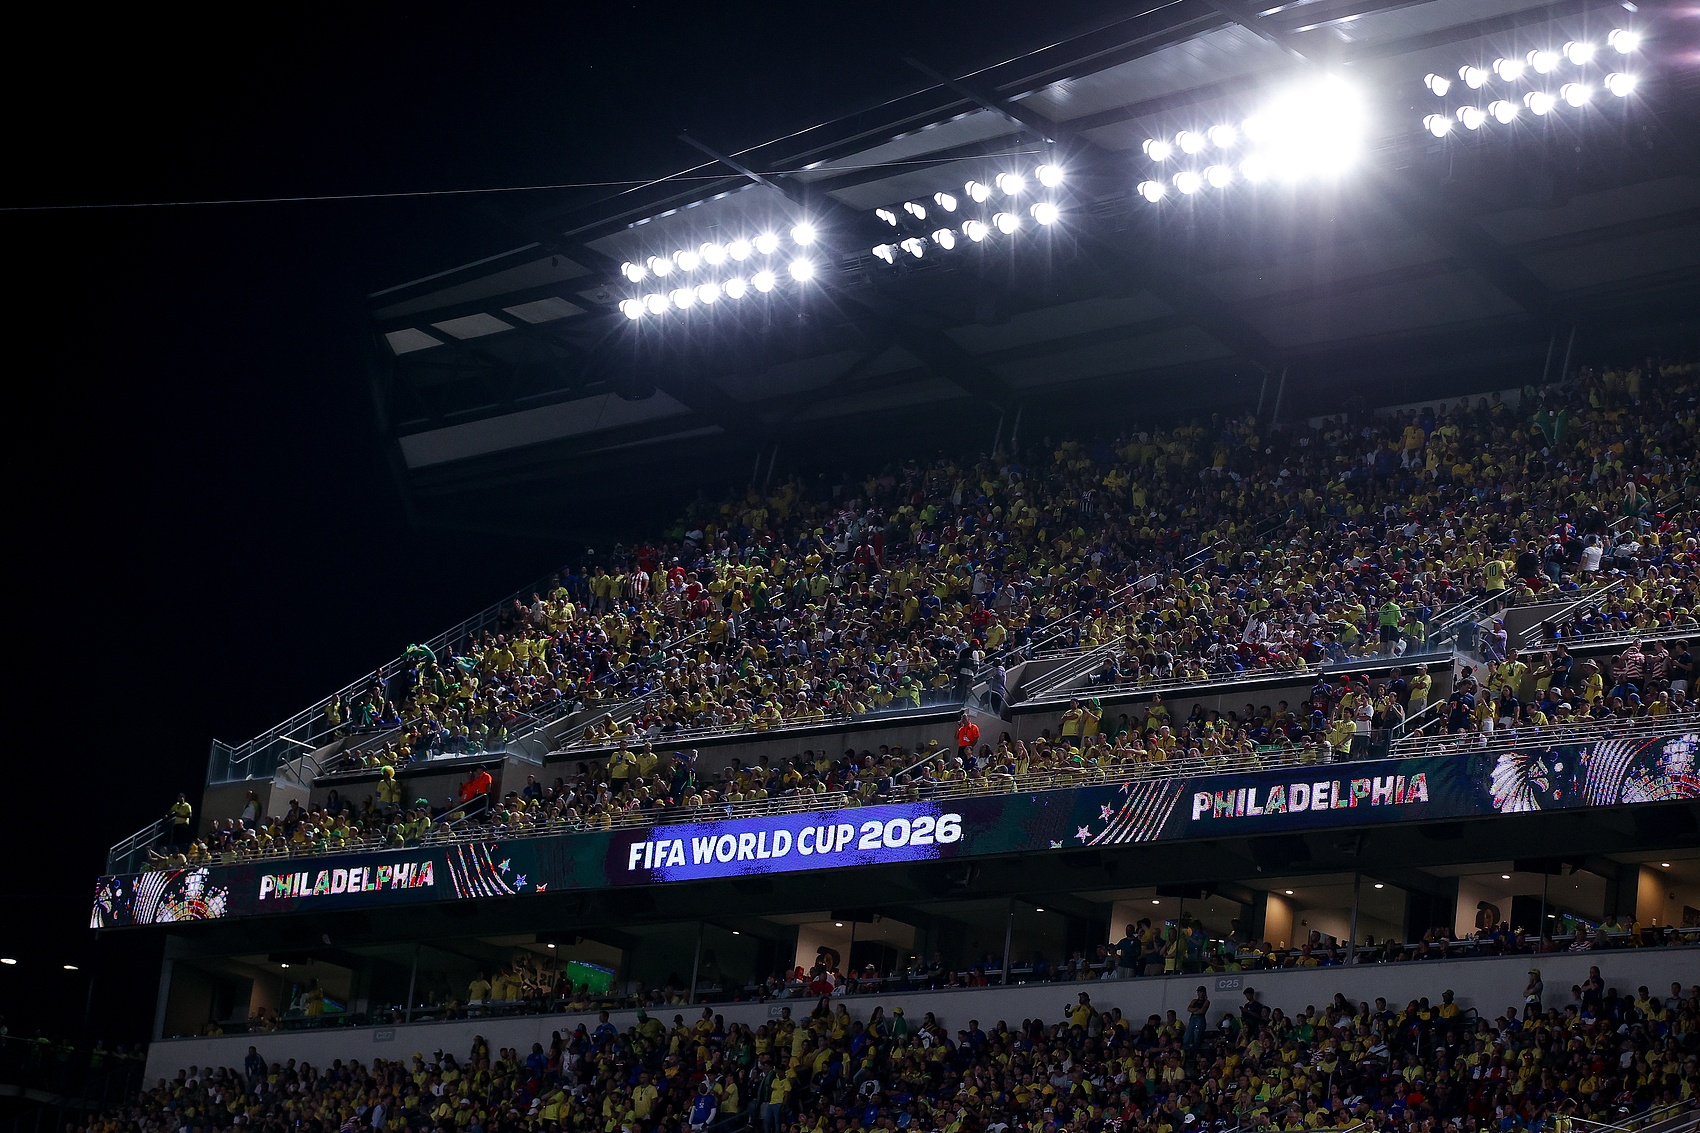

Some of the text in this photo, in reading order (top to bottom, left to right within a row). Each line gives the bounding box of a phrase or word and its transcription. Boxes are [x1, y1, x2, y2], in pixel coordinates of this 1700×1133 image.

[1489, 564, 1497, 577] 10
[1192, 773, 1429, 820] PHILADELPHIA
[628, 813, 962, 871] FIFA WORLD CUP 2026
[259, 860, 434, 900] PHILADELPHIA
[1219, 980, 1239, 989] C25
[376, 1031, 393, 1040] C27
